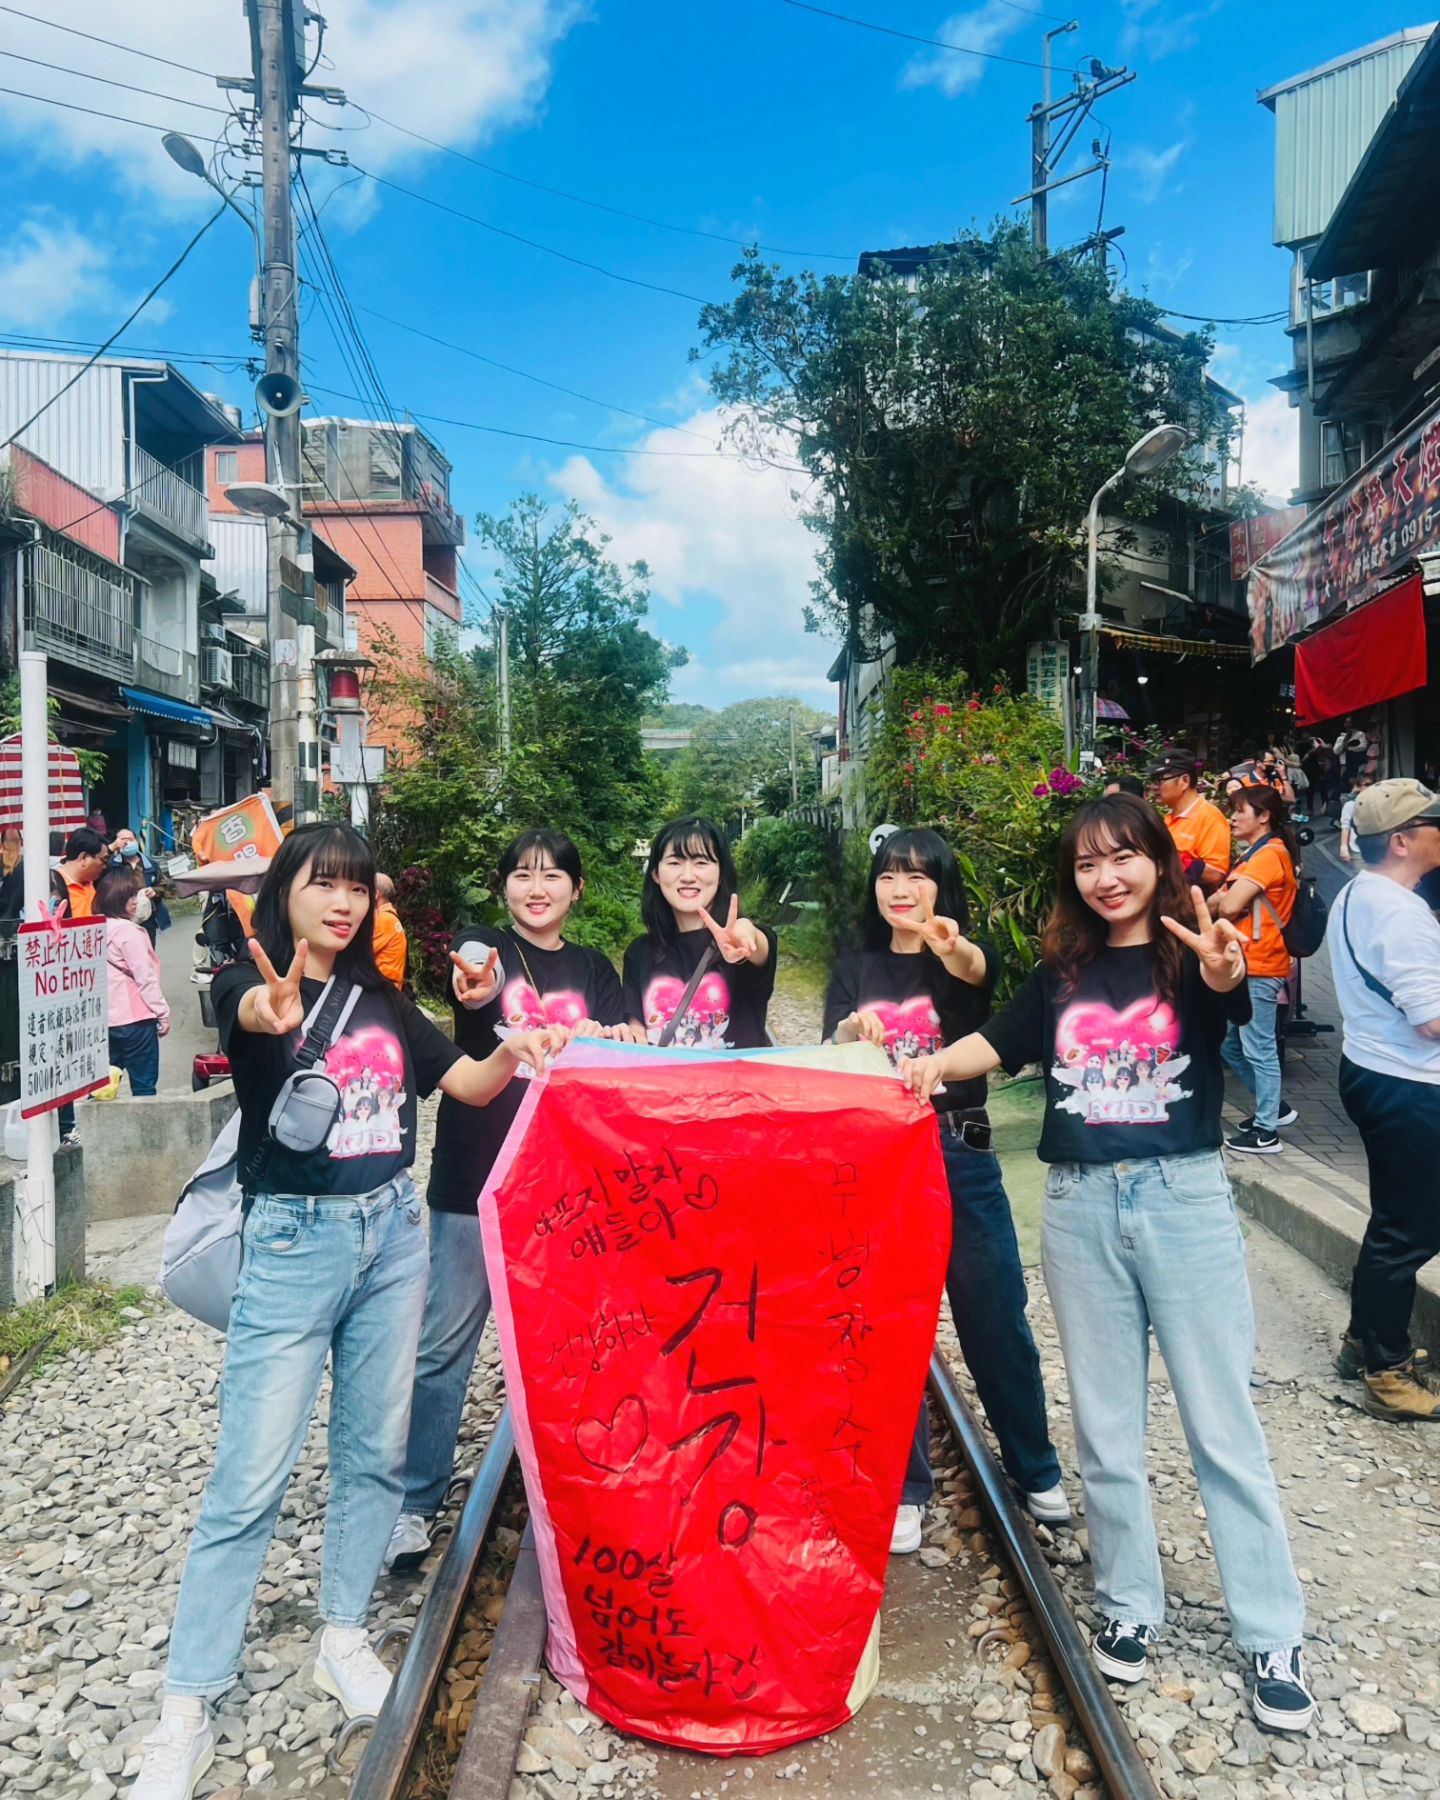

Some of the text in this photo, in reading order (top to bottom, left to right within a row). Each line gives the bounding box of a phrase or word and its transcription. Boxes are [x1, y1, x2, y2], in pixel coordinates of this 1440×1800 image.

[35, 965, 96, 997] No Entry
[534, 1147, 684, 1237] 아프지 말자
[660, 1260, 788, 1549] 건강
[574, 1536, 678, 1599] 100살
[584, 1584, 697, 1637] 넘어도
